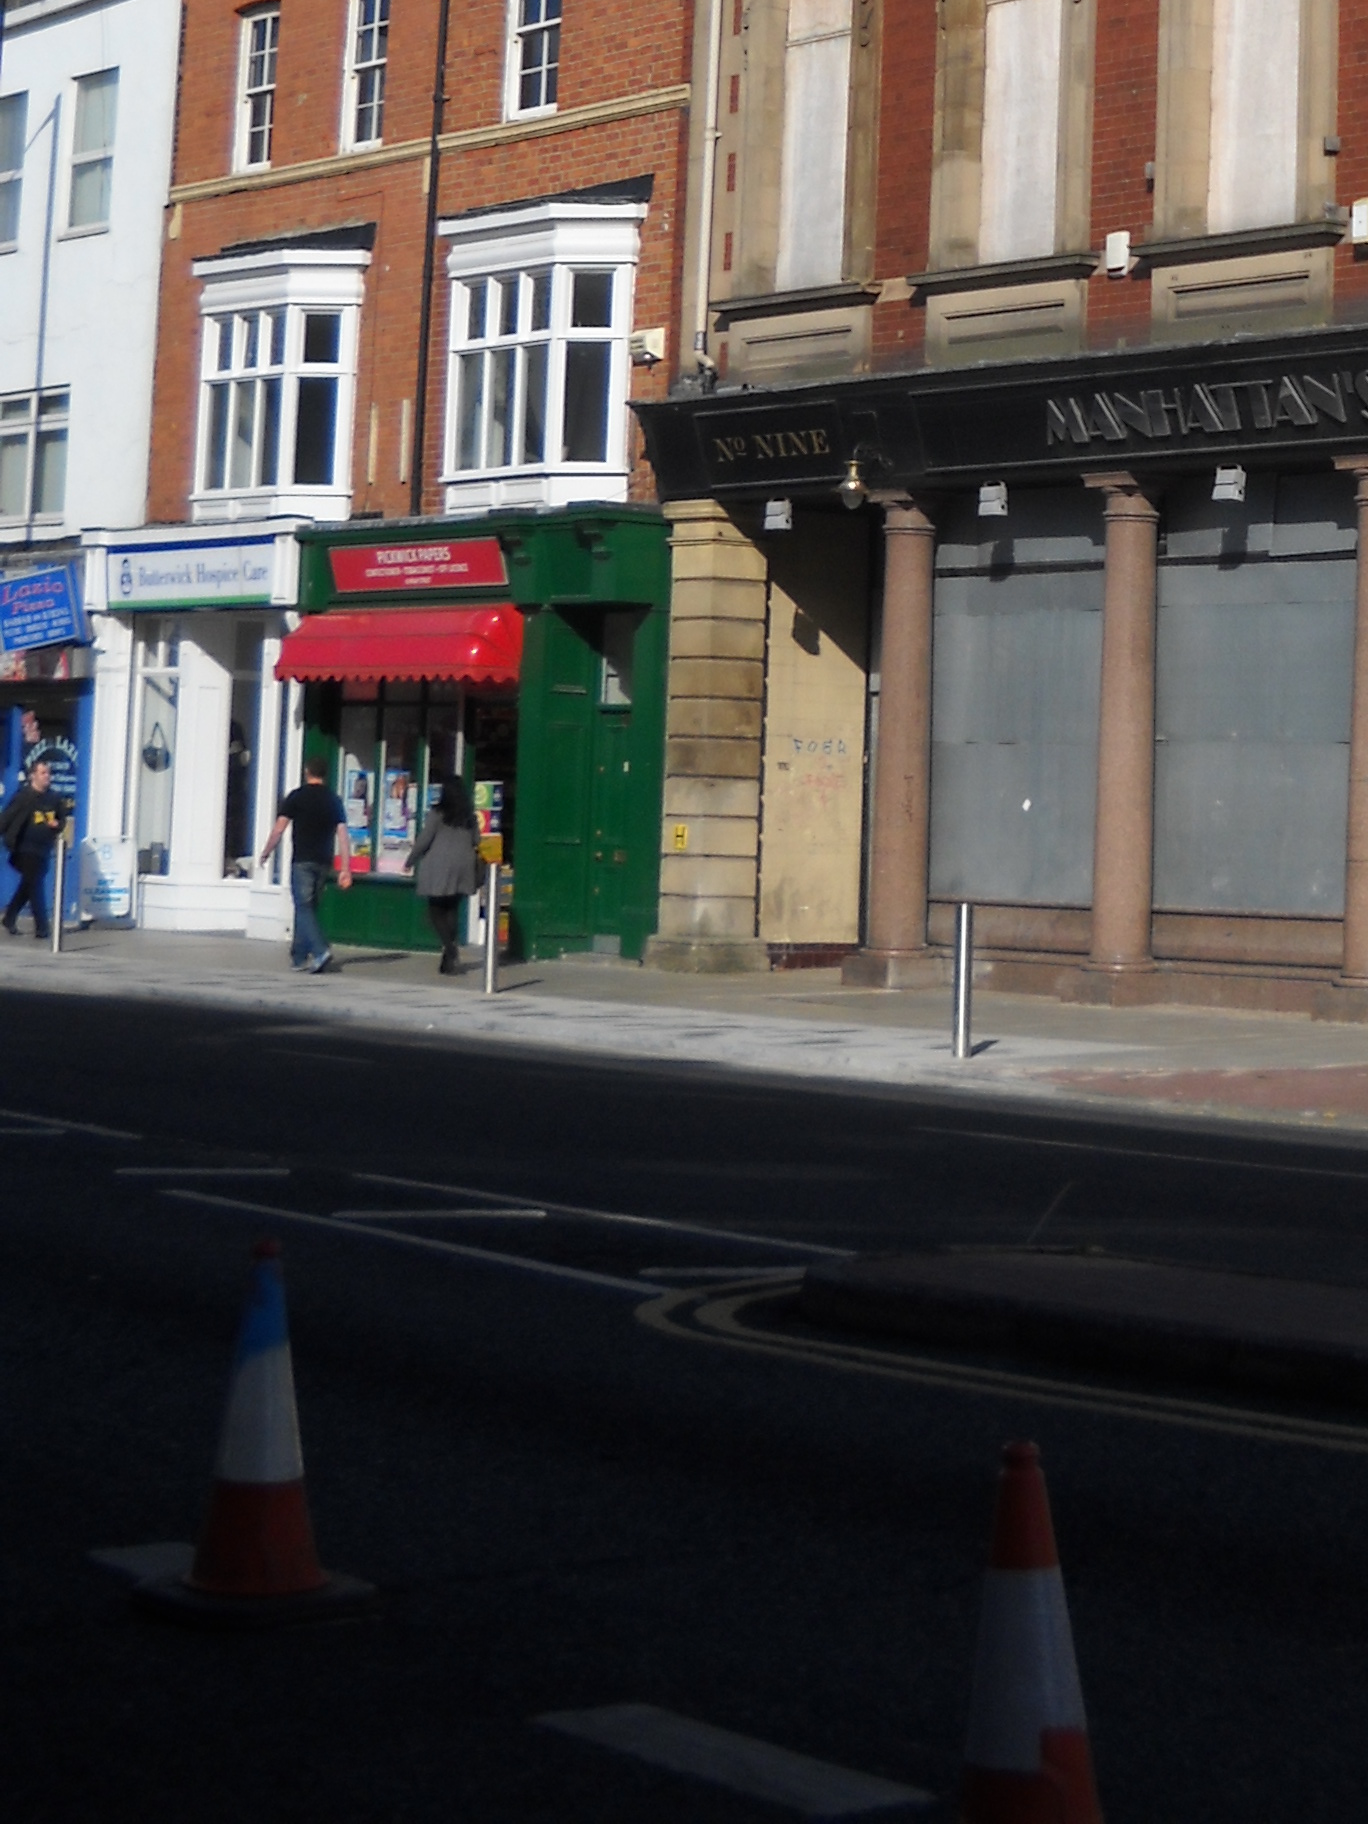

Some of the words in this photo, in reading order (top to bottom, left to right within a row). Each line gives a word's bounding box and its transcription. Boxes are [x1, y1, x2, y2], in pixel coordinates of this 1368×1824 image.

[752, 429, 831, 459] NINE
[138, 564, 192, 586] Butterwick
[196, 562, 238, 589] Hospice
[244, 560, 268, 581] Care
